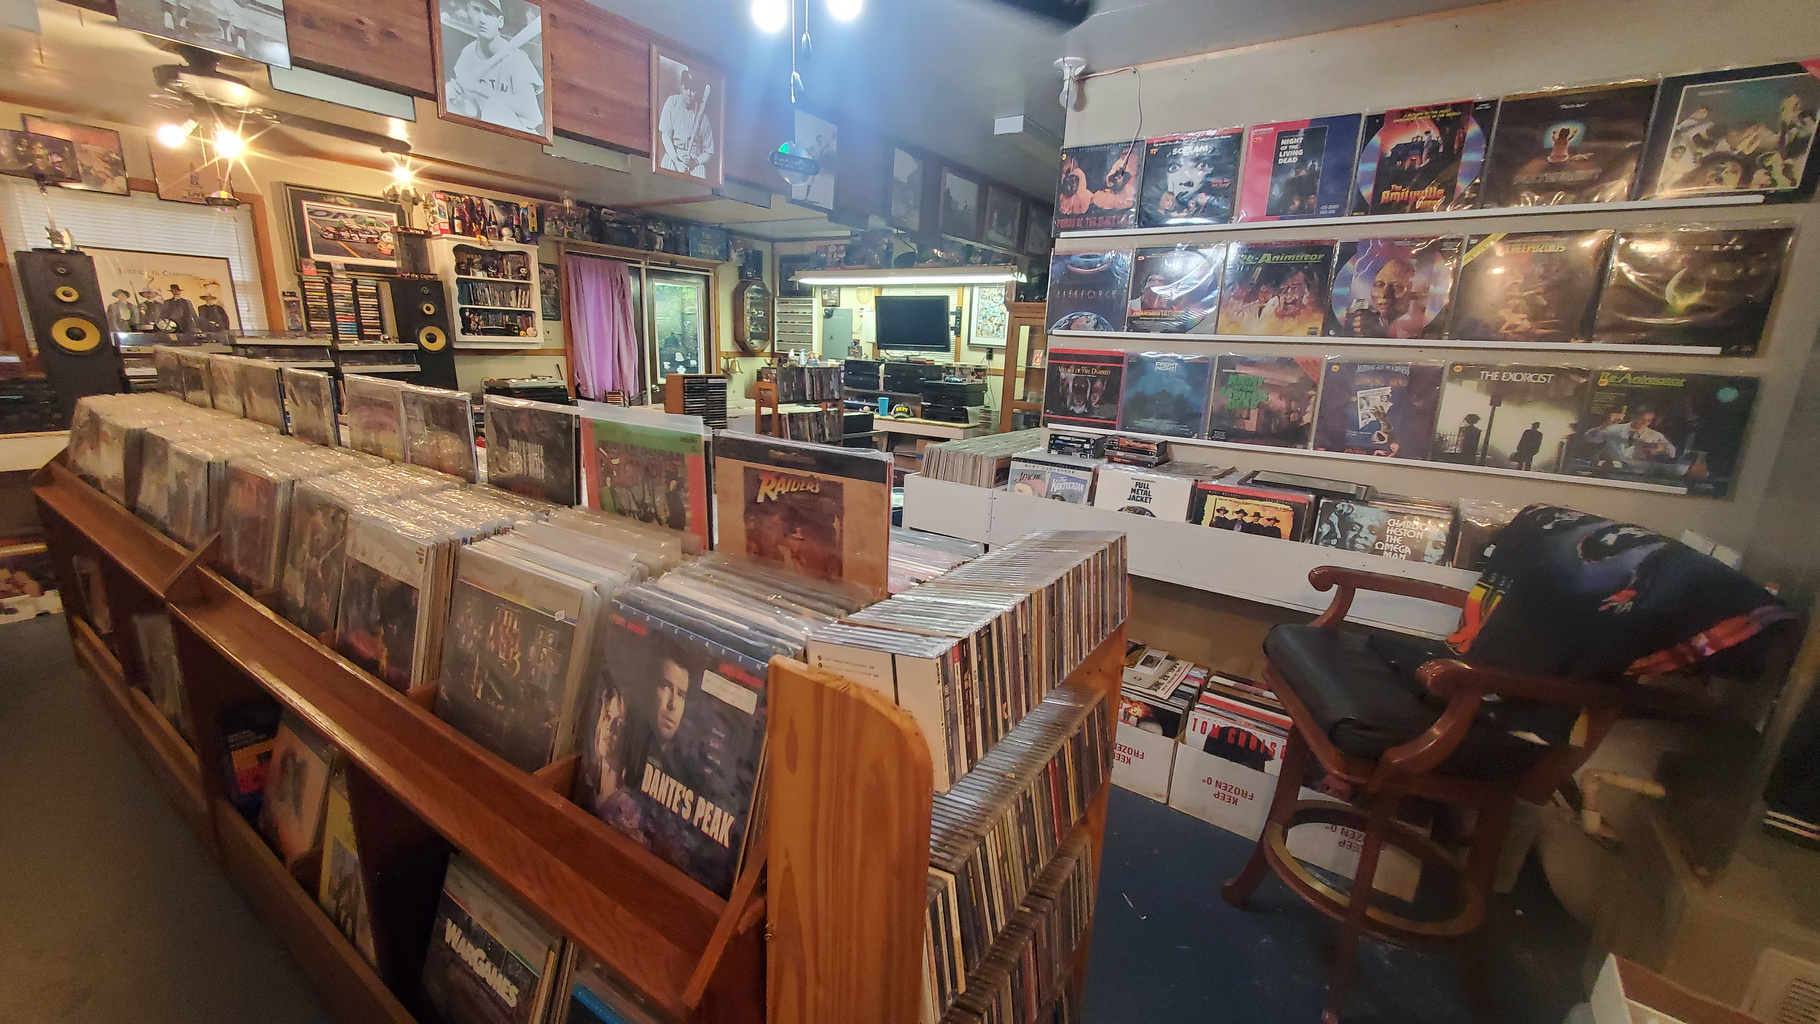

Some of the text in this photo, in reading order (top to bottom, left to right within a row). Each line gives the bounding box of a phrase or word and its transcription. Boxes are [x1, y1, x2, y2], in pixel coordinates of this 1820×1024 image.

[1281, 137, 1303, 145] NIGHT
[1279, 149, 1303, 157] LIVING
[1057, 289, 1117, 299] LIFEFORCE
[1480, 370, 1555, 383] THE EXORCIST
[756, 472, 821, 503] RAIDERS
[1131, 488, 1152, 496] METAL
[1127, 495, 1153, 504] JACKET
[1386, 527, 1424, 540] HESTON
[1386, 534, 1403, 545] THE
[1192, 717, 1221, 739] TOM
[641, 762, 695, 820] DANTE'S
[1215, 779, 1254, 801] FROZEN
[1213, 791, 1239, 806] KEEP
[692, 795, 735, 849] PEAK
[1338, 839, 1362, 853] EEP
